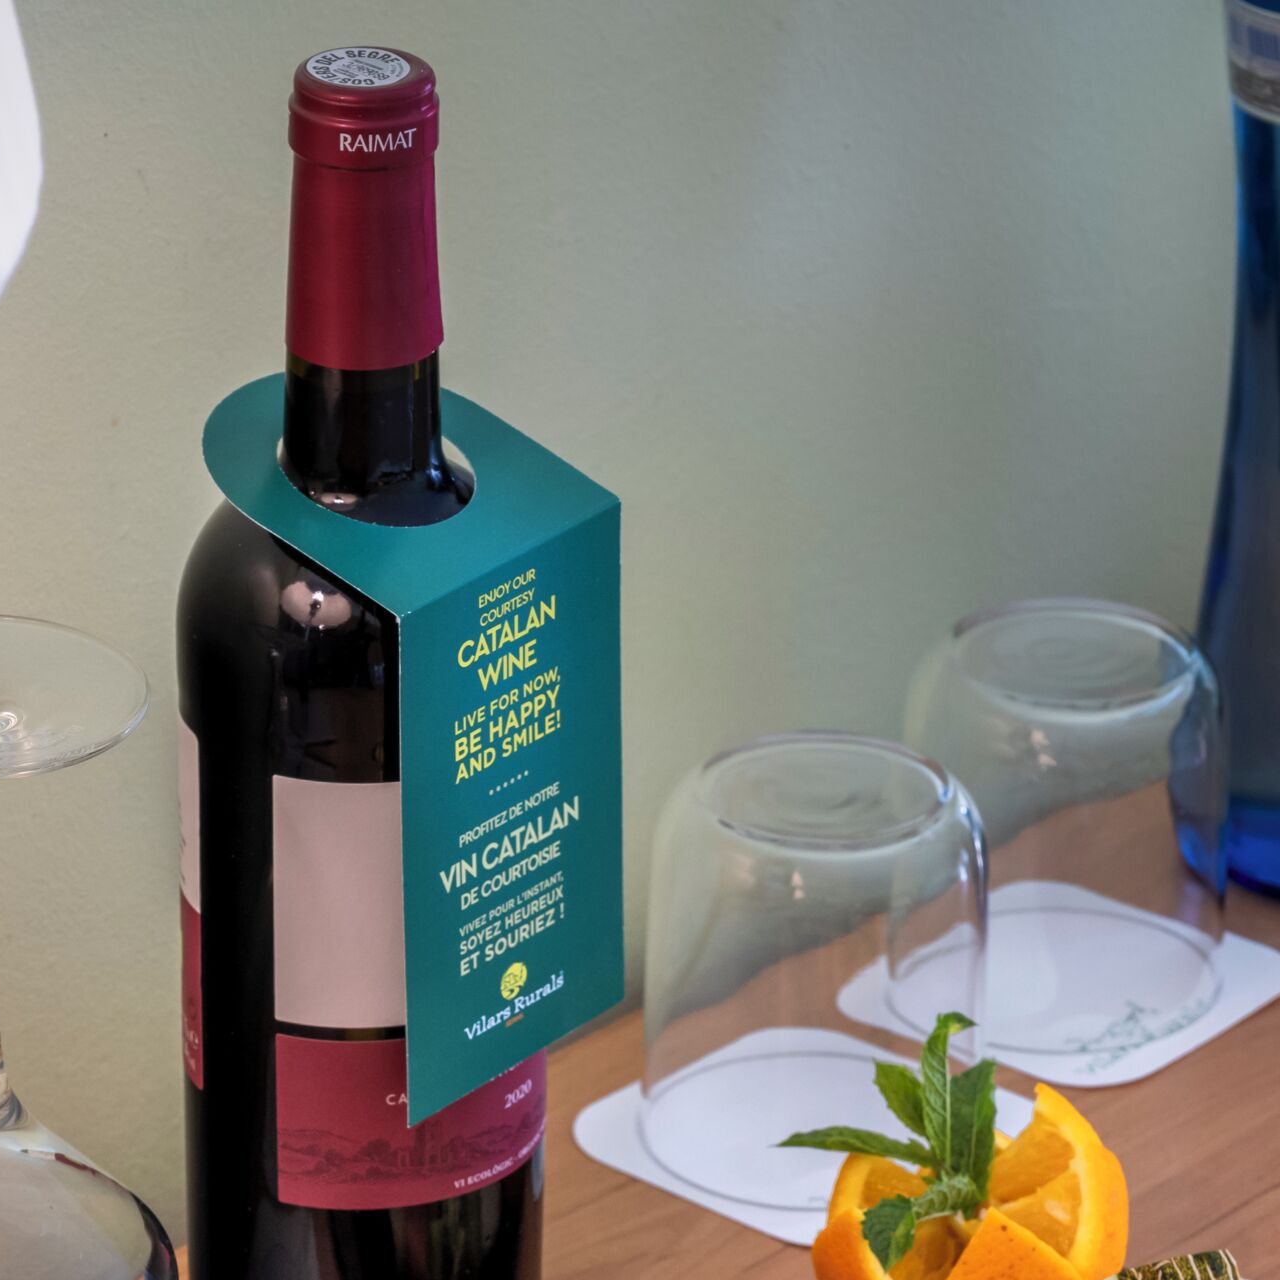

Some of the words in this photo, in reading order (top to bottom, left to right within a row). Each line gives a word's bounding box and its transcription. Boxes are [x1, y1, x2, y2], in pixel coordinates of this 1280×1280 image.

[312, 65, 375, 86] COSTERS
[315, 53, 345, 66] DEL
[345, 50, 401, 64] SEGRE
[339, 127, 417, 153] RAIMAT
[478, 580, 511, 609] ENJOY
[512, 568, 536, 590] OUR
[479, 588, 536, 627] COURTESY
[457, 594, 556, 668] CATALAN
[477, 639, 537, 691] WINE
[454, 706, 485, 735] LIVE
[490, 688, 519, 716] FOR
[523, 666, 560, 698] NOW,
[454, 728, 482, 762] BE
[489, 685, 560, 743] HAPPY
[455, 747, 496, 785] AND
[502, 710, 561, 758] SMILE!
[458, 810, 508, 848] PROFITEZ
[509, 802, 524, 820] DE
[524, 782, 560, 811] NOTRE
[439, 853, 477, 894] VIN
[481, 796, 579, 870] CATALAN
[460, 889, 479, 911] DE
[481, 841, 561, 899] COURTOISIE
[458, 914, 487, 937] VIVEZ
[489, 898, 515, 920] POUR
[459, 920, 502, 956] SOYEZ
[505, 885, 564, 931] HEUREUX
[460, 952, 480, 977] ET
[484, 911, 556, 963] SOURIEZ
[464, 1003, 511, 1040] Vilars
[513, 973, 565, 1015] Rurals
[503, 1078, 533, 1109] 2020
[453, 1178, 465, 1190] VI
